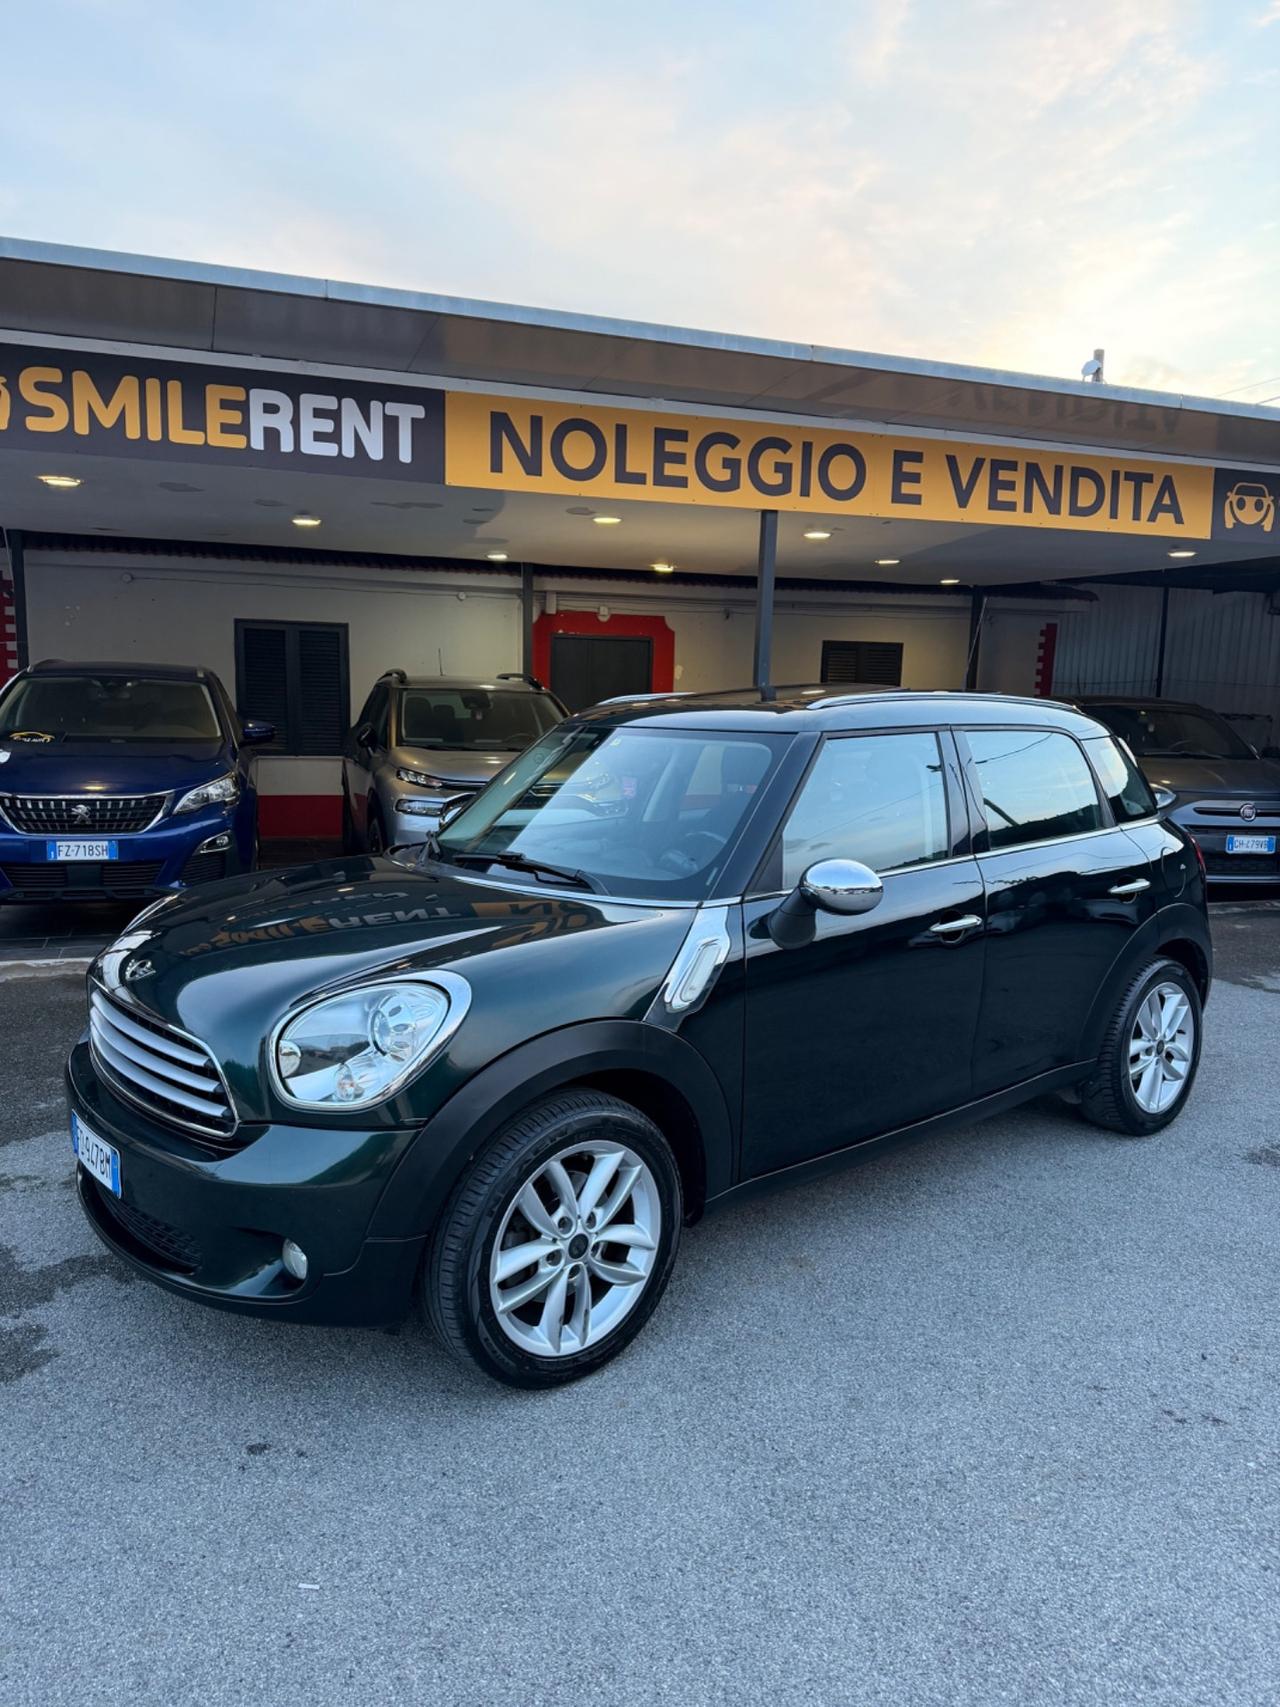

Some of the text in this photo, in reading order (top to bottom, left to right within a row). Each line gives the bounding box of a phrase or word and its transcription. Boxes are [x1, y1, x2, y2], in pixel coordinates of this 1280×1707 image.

[18, 366, 426, 464] SMILERENT
[490, 411, 1185, 525] NOLEGGIO E VENDITA
